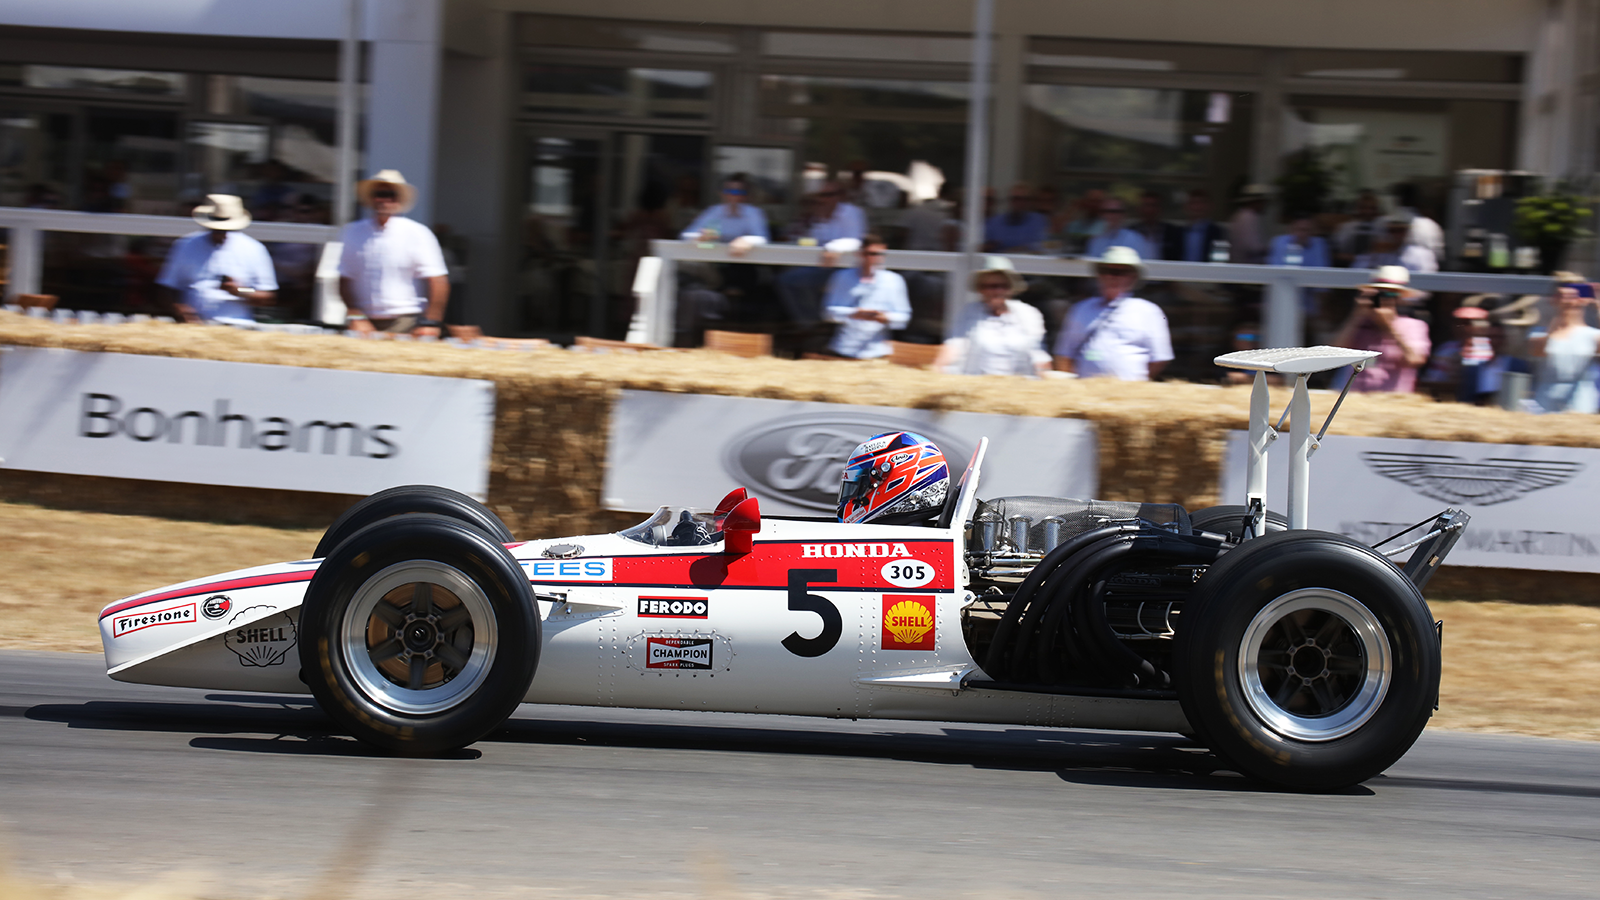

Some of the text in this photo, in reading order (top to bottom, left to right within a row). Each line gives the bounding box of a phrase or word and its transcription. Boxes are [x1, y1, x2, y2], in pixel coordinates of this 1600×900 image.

[78, 392, 401, 459] Bonhams
[801, 543, 913, 558] HONDA
[890, 566, 925, 580] 305
[640, 600, 707, 614] FERODO
[781, 569, 843, 658] 5
[118, 609, 190, 632] Firestone
[891, 616, 927, 627] SHELL
[236, 627, 288, 643] SHELL
[653, 649, 707, 658] CHAMPION
